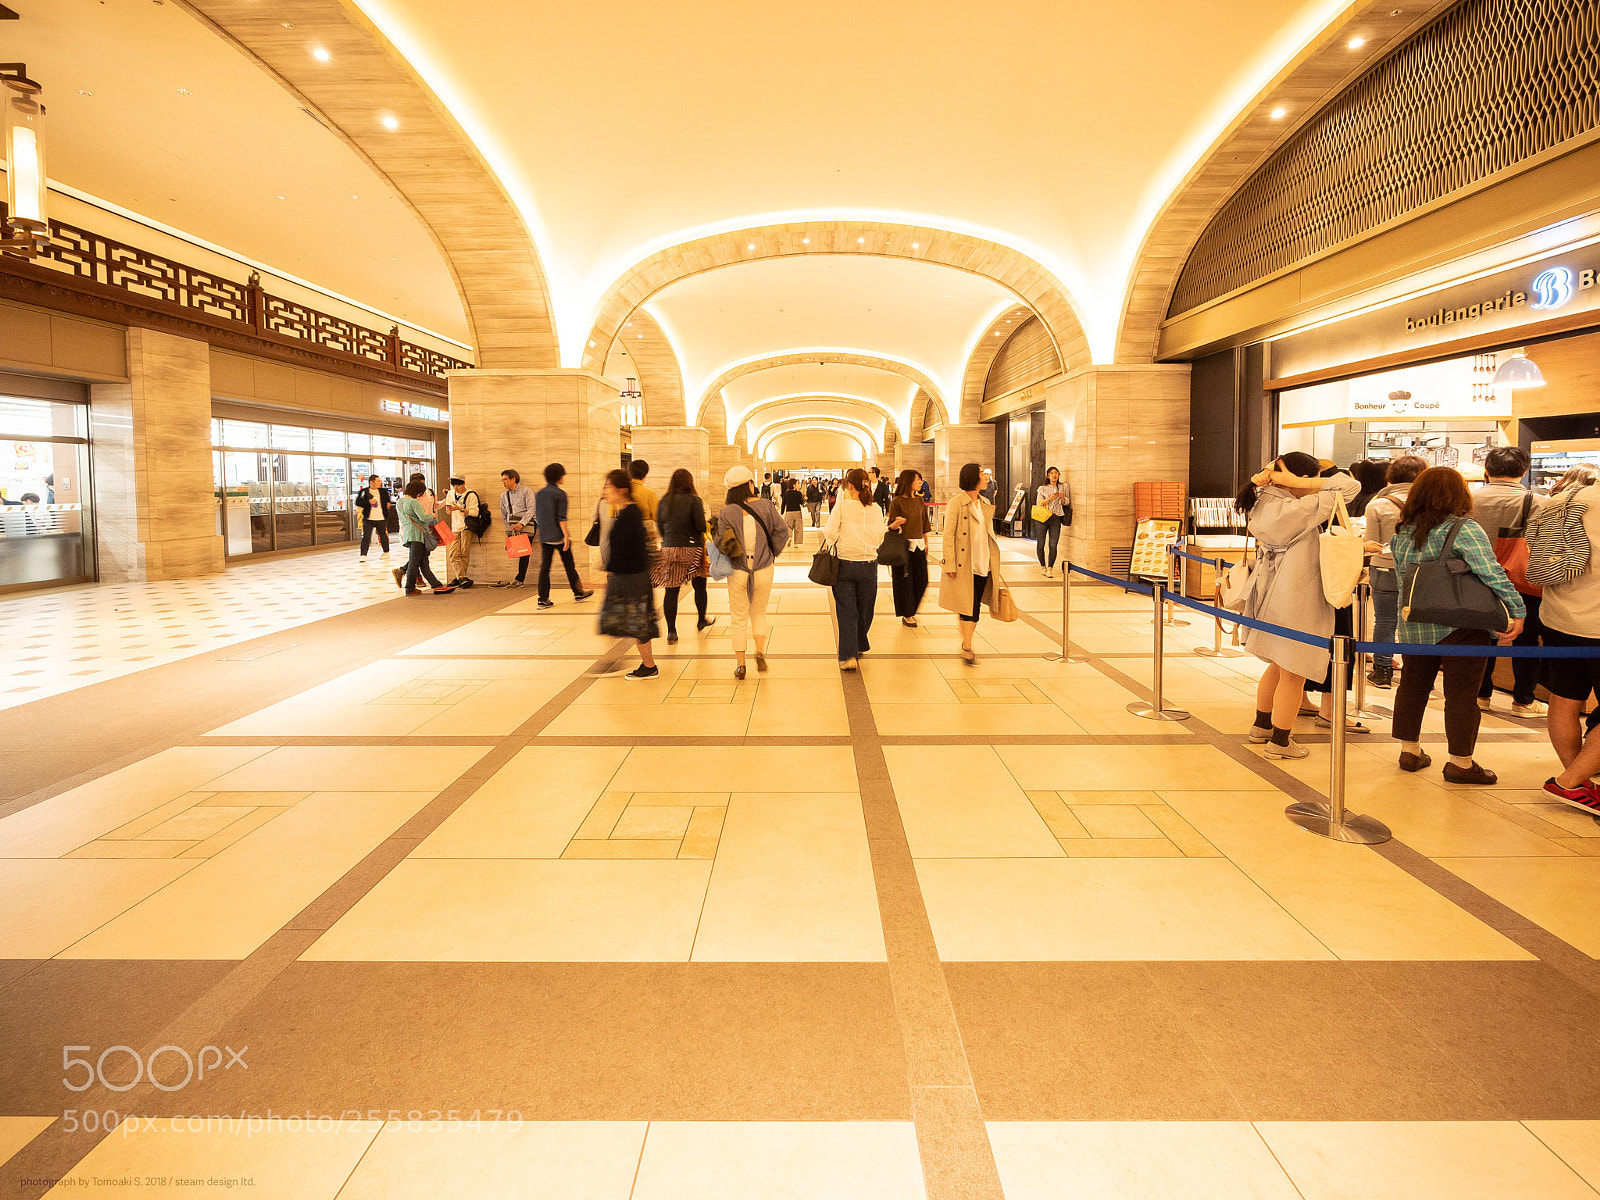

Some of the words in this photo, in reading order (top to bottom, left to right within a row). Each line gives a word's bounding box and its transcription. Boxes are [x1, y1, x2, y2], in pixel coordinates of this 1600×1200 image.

[1404, 290, 1527, 333] boulangerie
[1578, 268, 1600, 290] B
[1354, 402, 1386, 410] Bonheur
